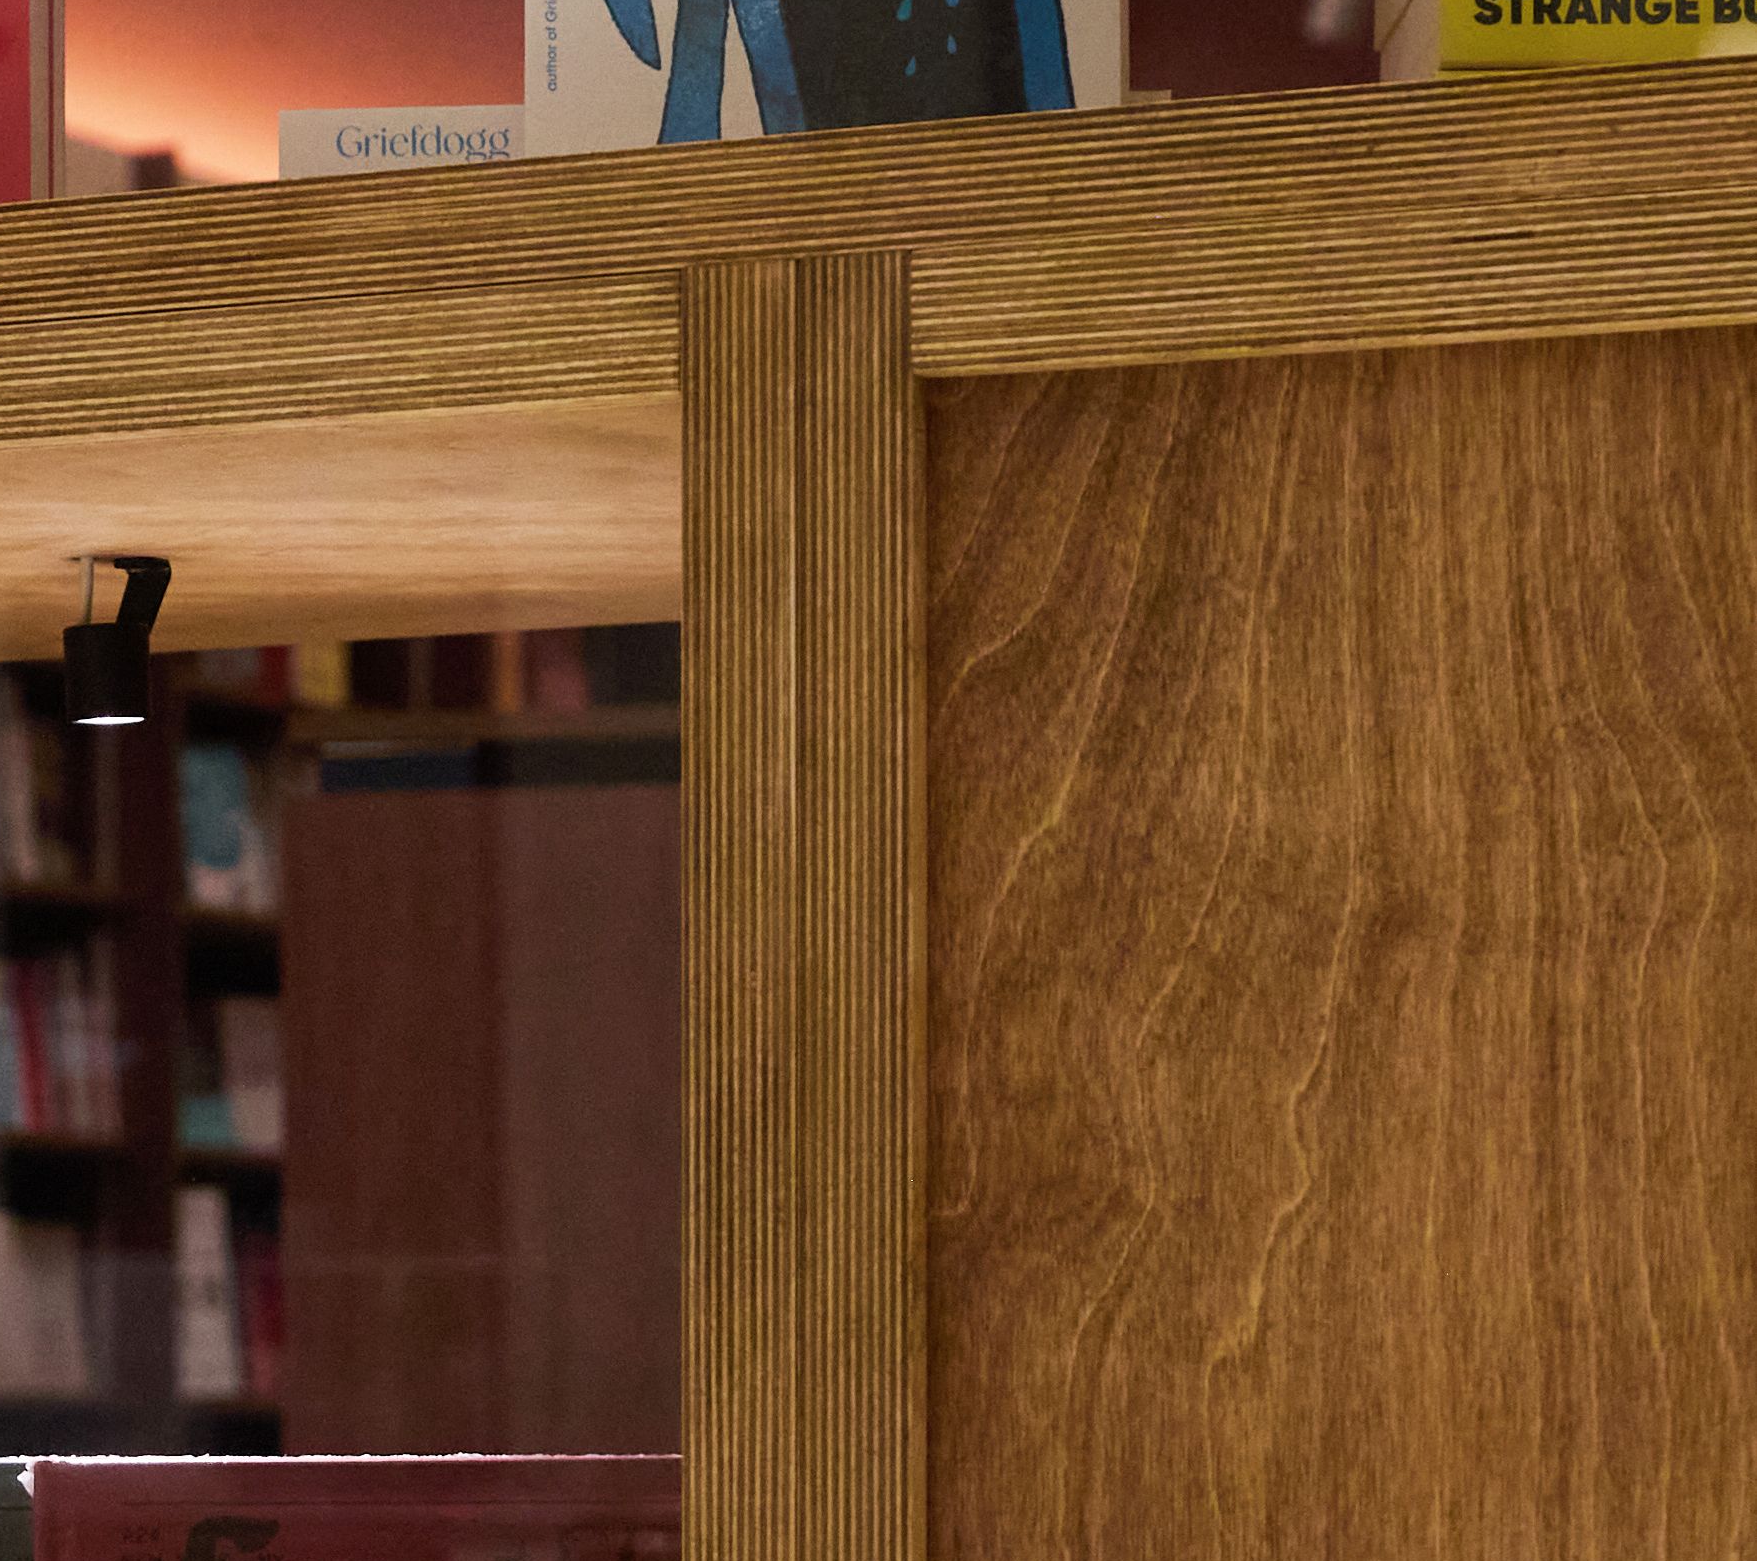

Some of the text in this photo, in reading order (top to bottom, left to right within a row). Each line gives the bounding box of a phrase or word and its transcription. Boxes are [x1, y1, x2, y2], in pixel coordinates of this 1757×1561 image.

[546, 25, 557, 41] of
[546, 44, 558, 92] author
[336, 124, 510, 161] Griefdogg
